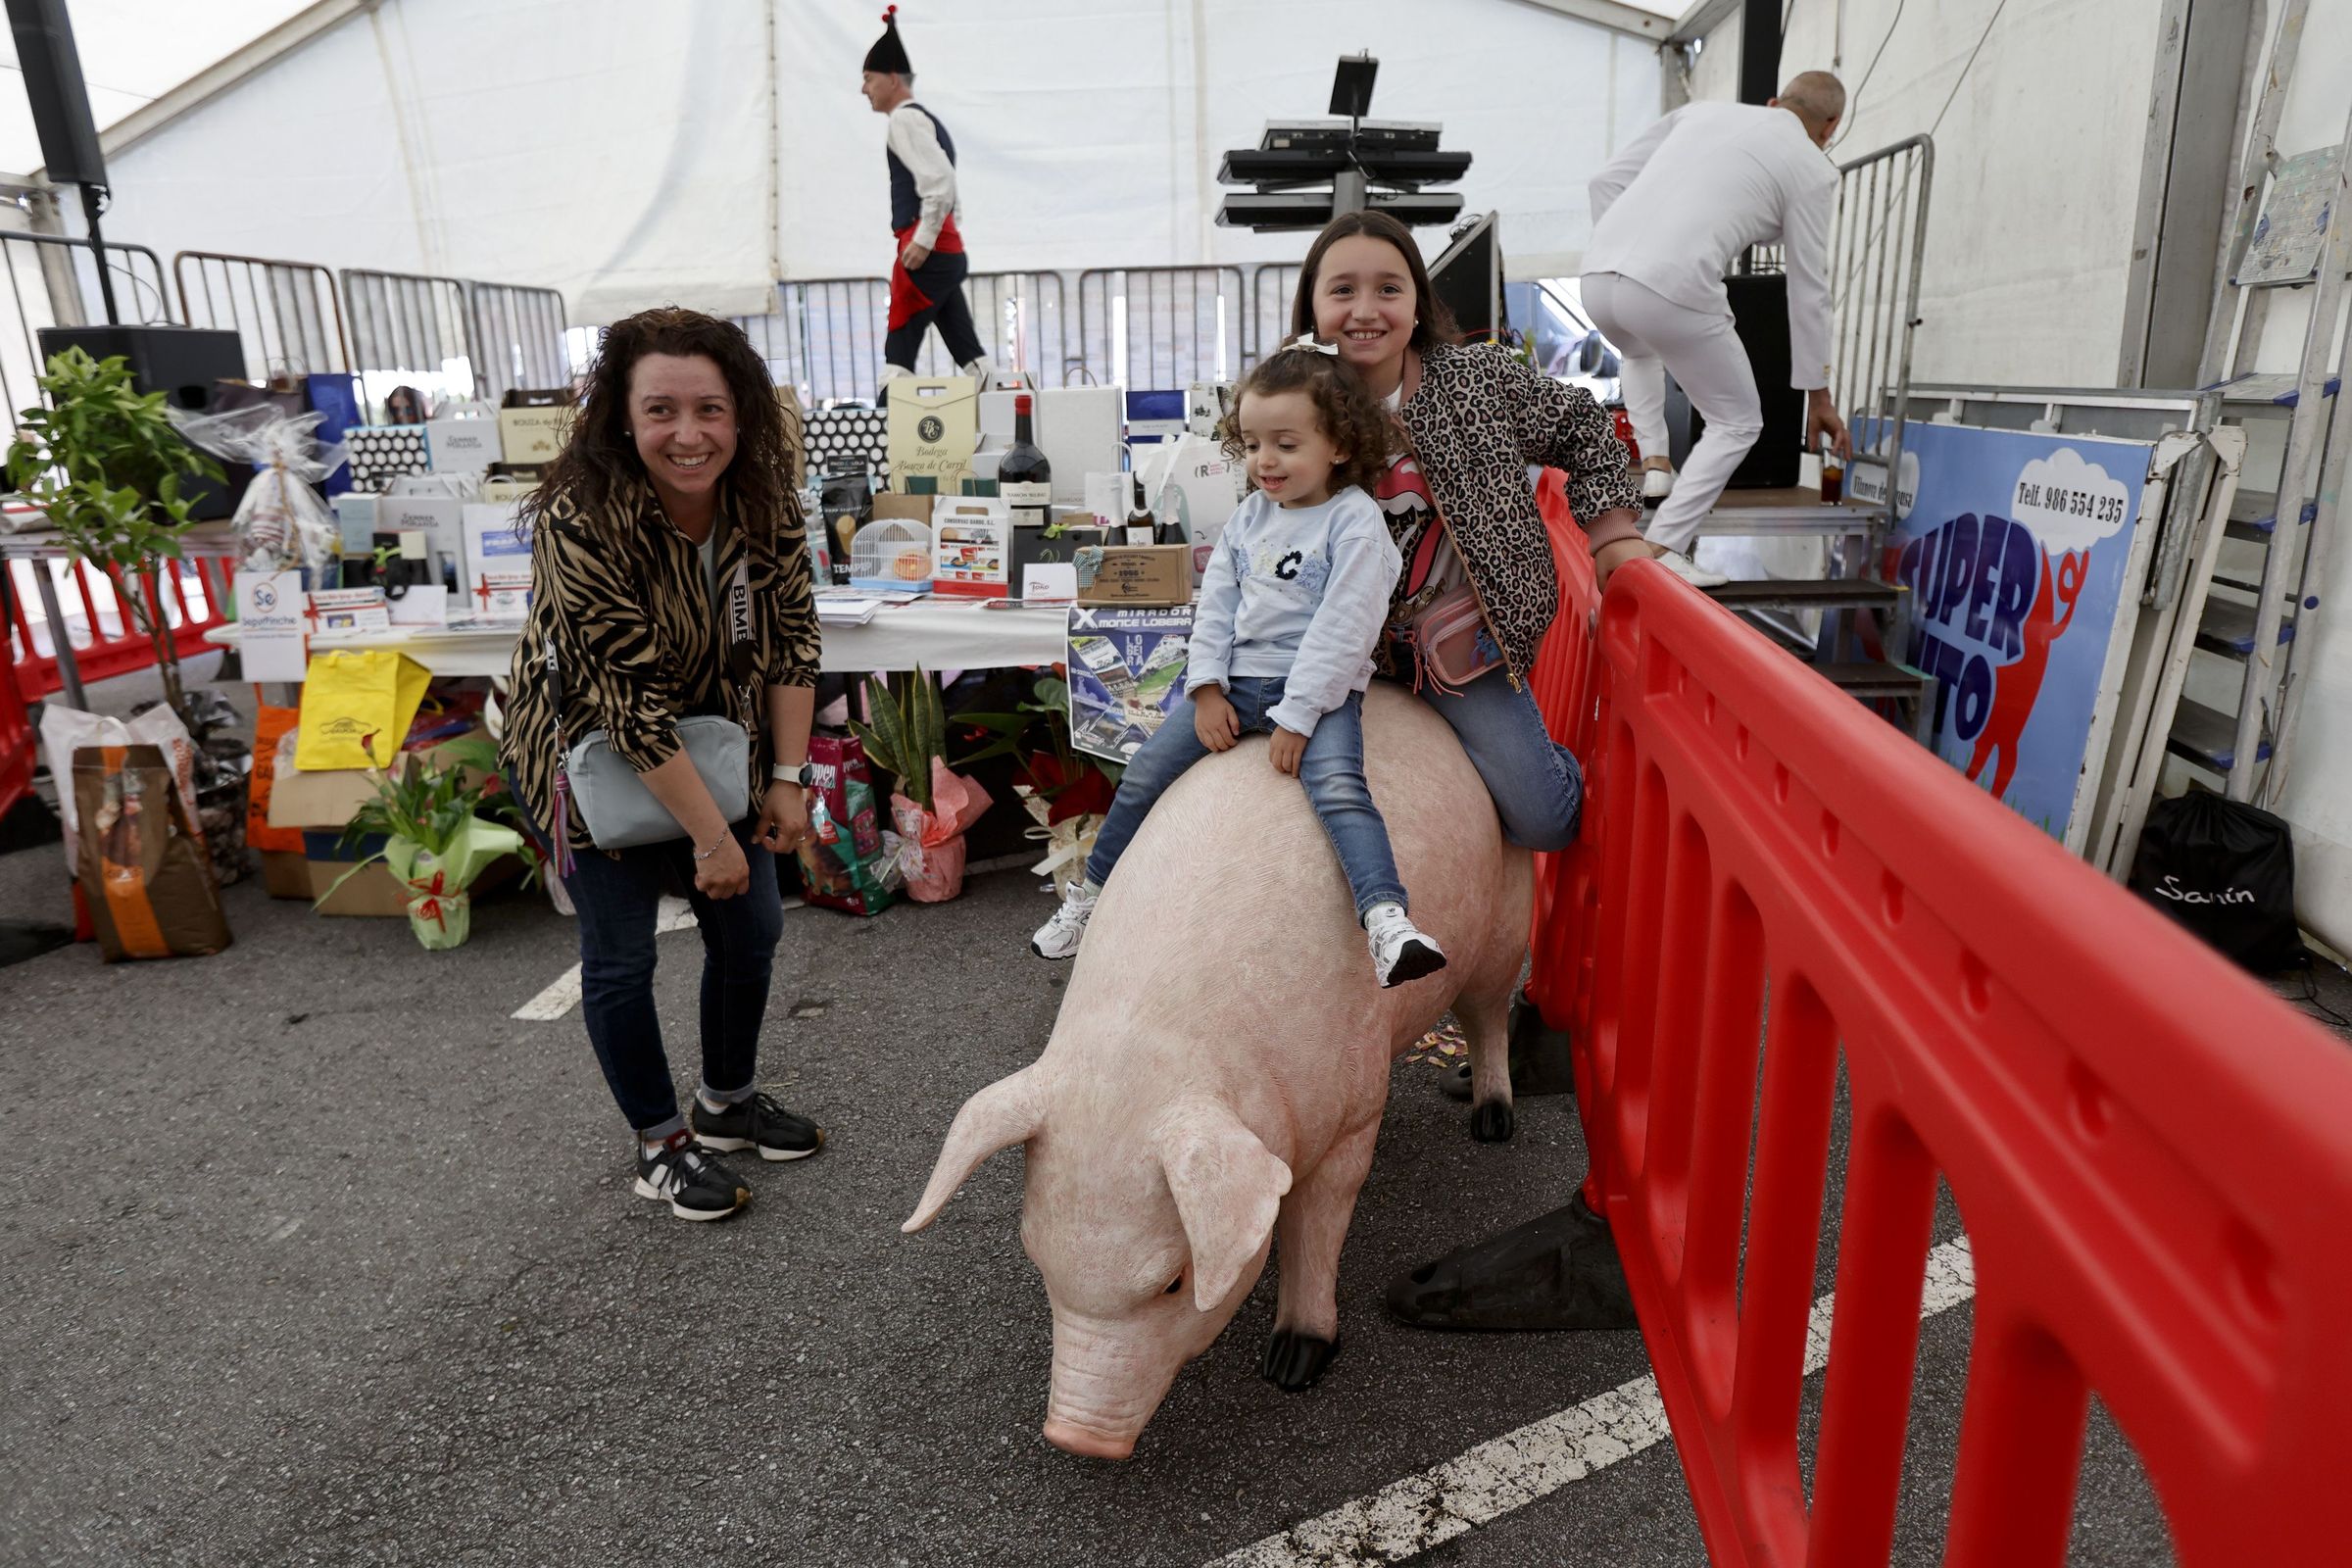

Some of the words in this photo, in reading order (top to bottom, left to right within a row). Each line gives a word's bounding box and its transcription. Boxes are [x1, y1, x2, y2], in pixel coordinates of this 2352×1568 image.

[916, 446, 949, 458] Bodega
[2019, 481, 2041, 507] Telf.
[2045, 486, 2068, 513] 986
[2070, 491, 2095, 518] 554
[2096, 496, 2125, 524] 235
[1117, 608, 1192, 617] MIRADOR
[1099, 618, 1140, 628] MONTE
[1142, 617, 1193, 627] LOBEIRA
